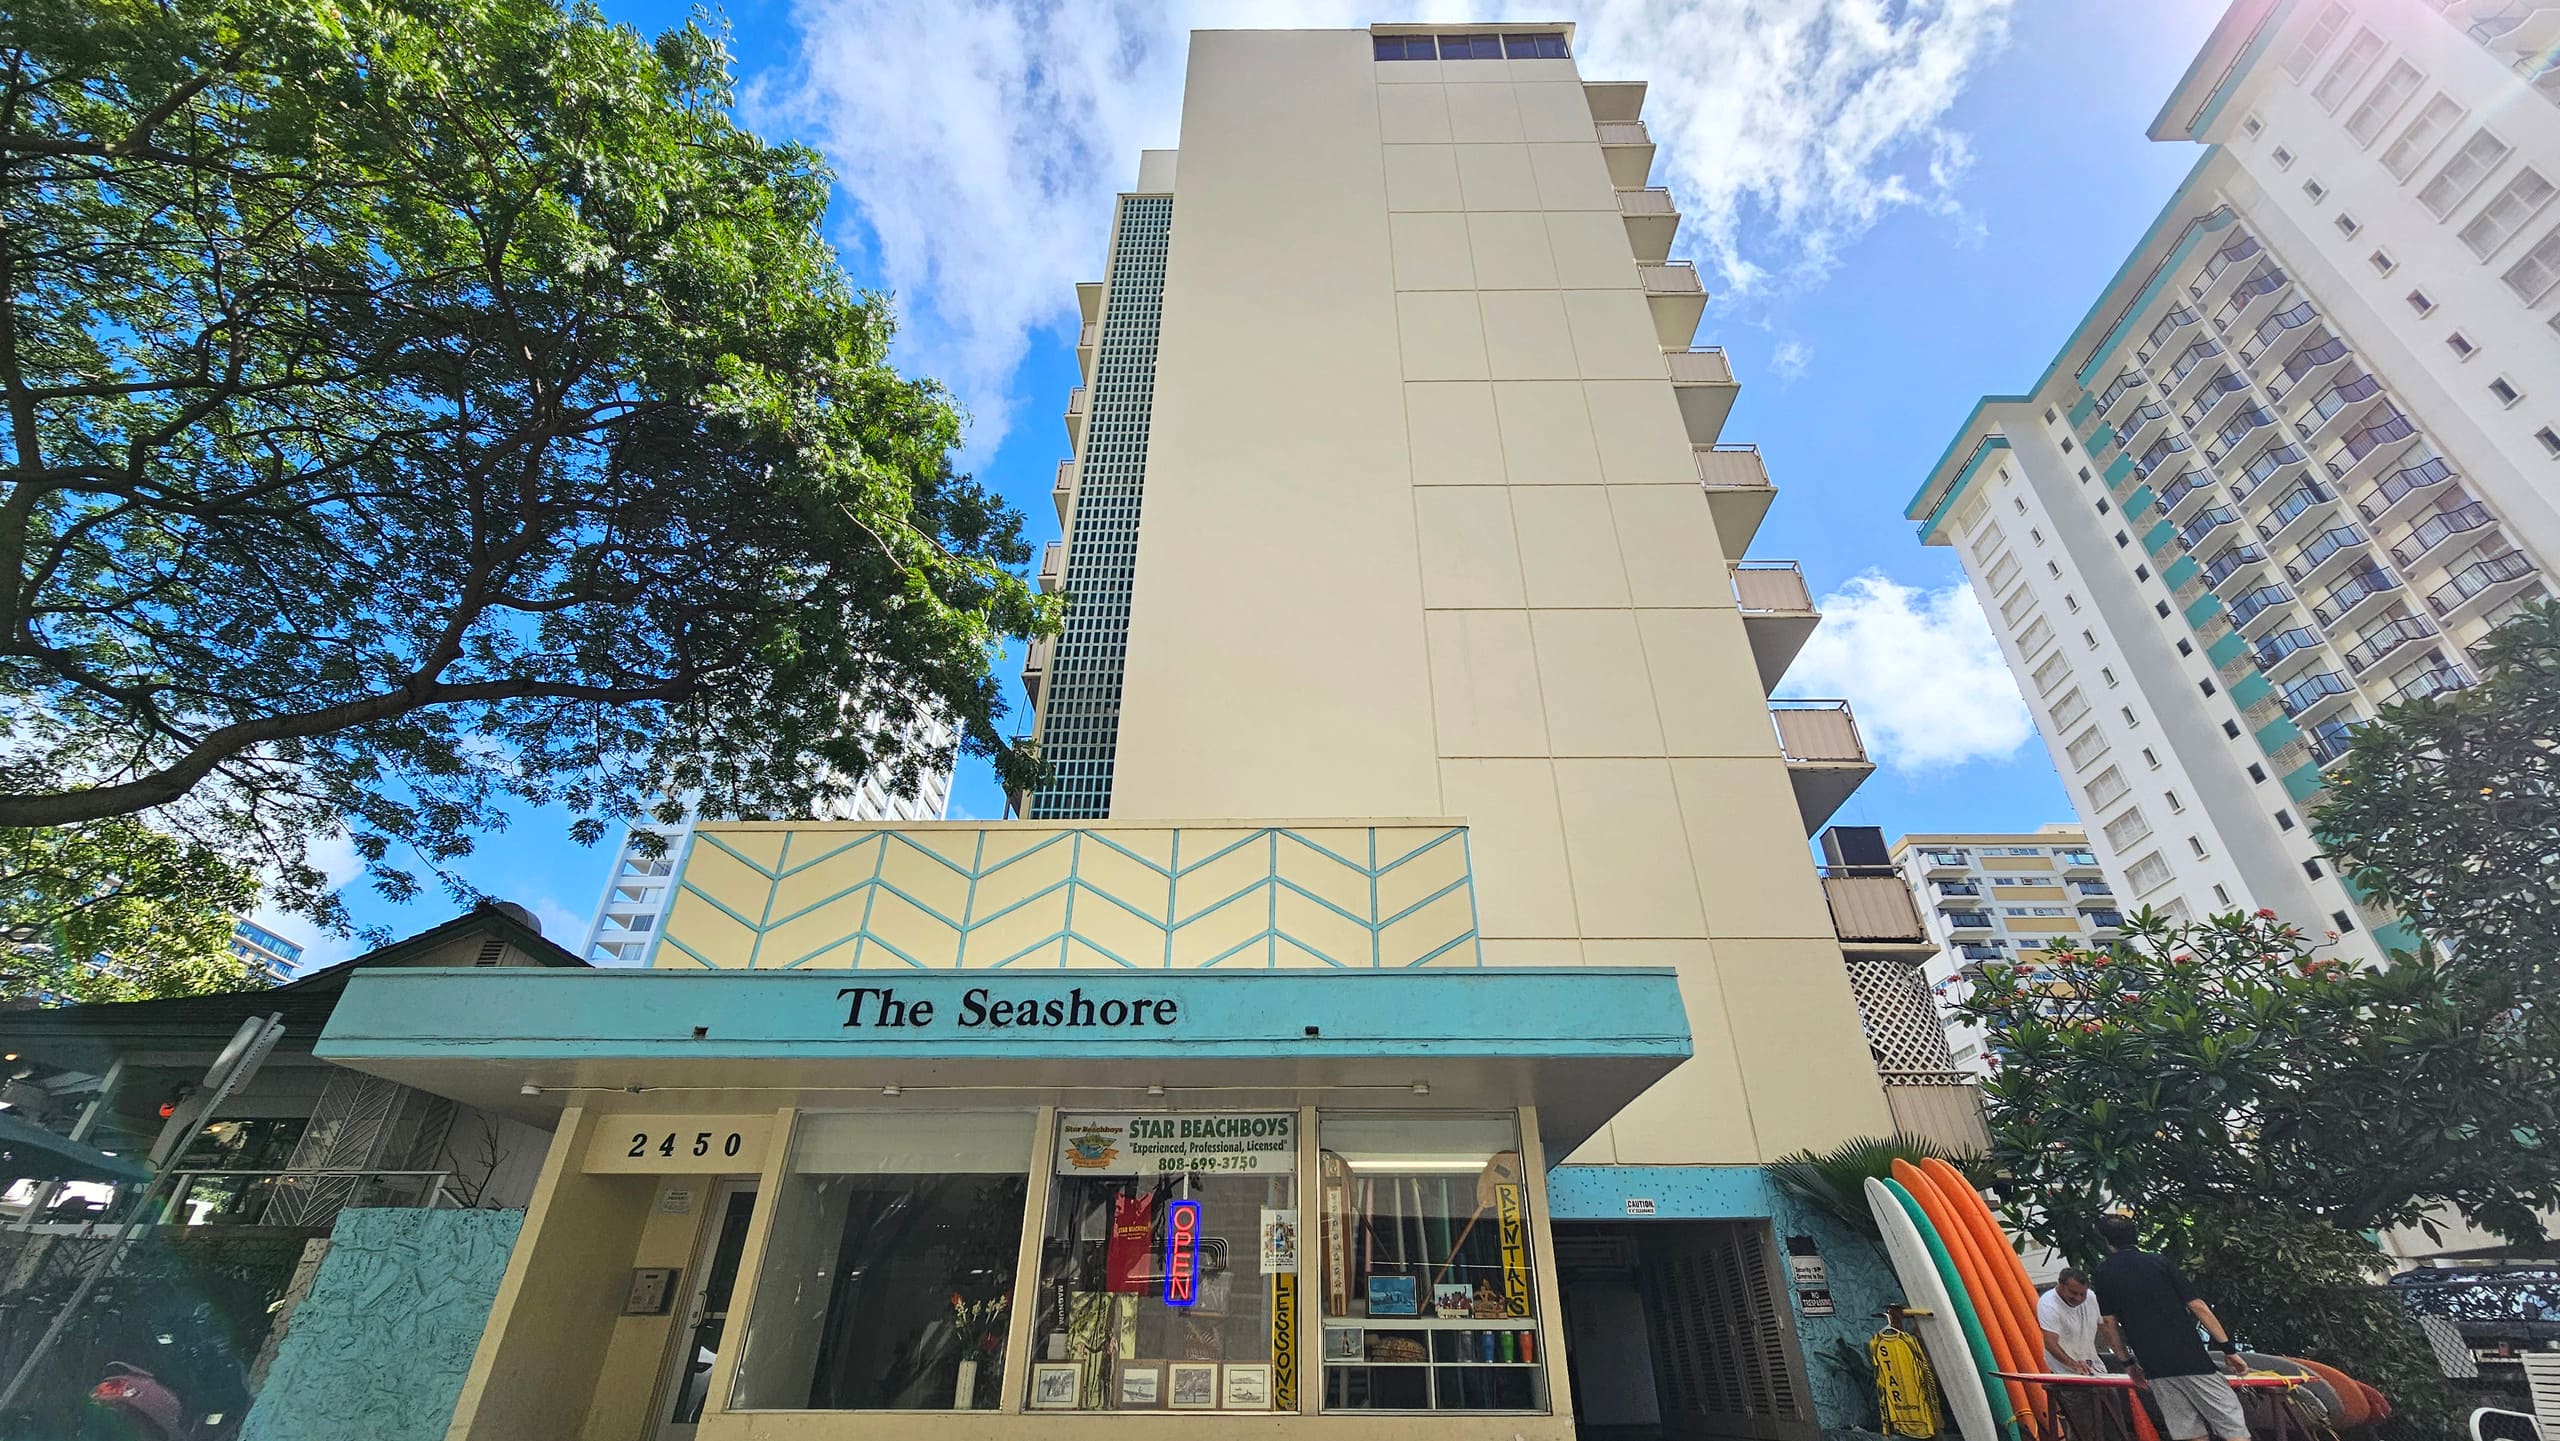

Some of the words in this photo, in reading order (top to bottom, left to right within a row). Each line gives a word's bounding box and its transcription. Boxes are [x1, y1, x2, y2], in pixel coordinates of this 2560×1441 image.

[837, 987, 934, 1028] The
[958, 987, 1178, 1028] Seashore
[1082, 1126, 1124, 1134] Beachboys
[1129, 1119, 1175, 1139] STAR
[1180, 1117, 1289, 1138] BEACHBOYS
[628, 1132, 742, 1158] 2450
[1129, 1142, 1187, 1157] "Experienced,
[1189, 1141, 1245, 1155] Professional,
[1247, 1139, 1288, 1152] Licensed"
[1158, 1155, 1258, 1171] 808-699-3750
[1627, 1200, 1654, 1208] CAUTION
[1171, 1206, 1195, 1300] OPEN
[1500, 1186, 1525, 1315] RENTALS
[1274, 1272, 1292, 1411] LESSONS
[1880, 1346, 1902, 1402] STAR
